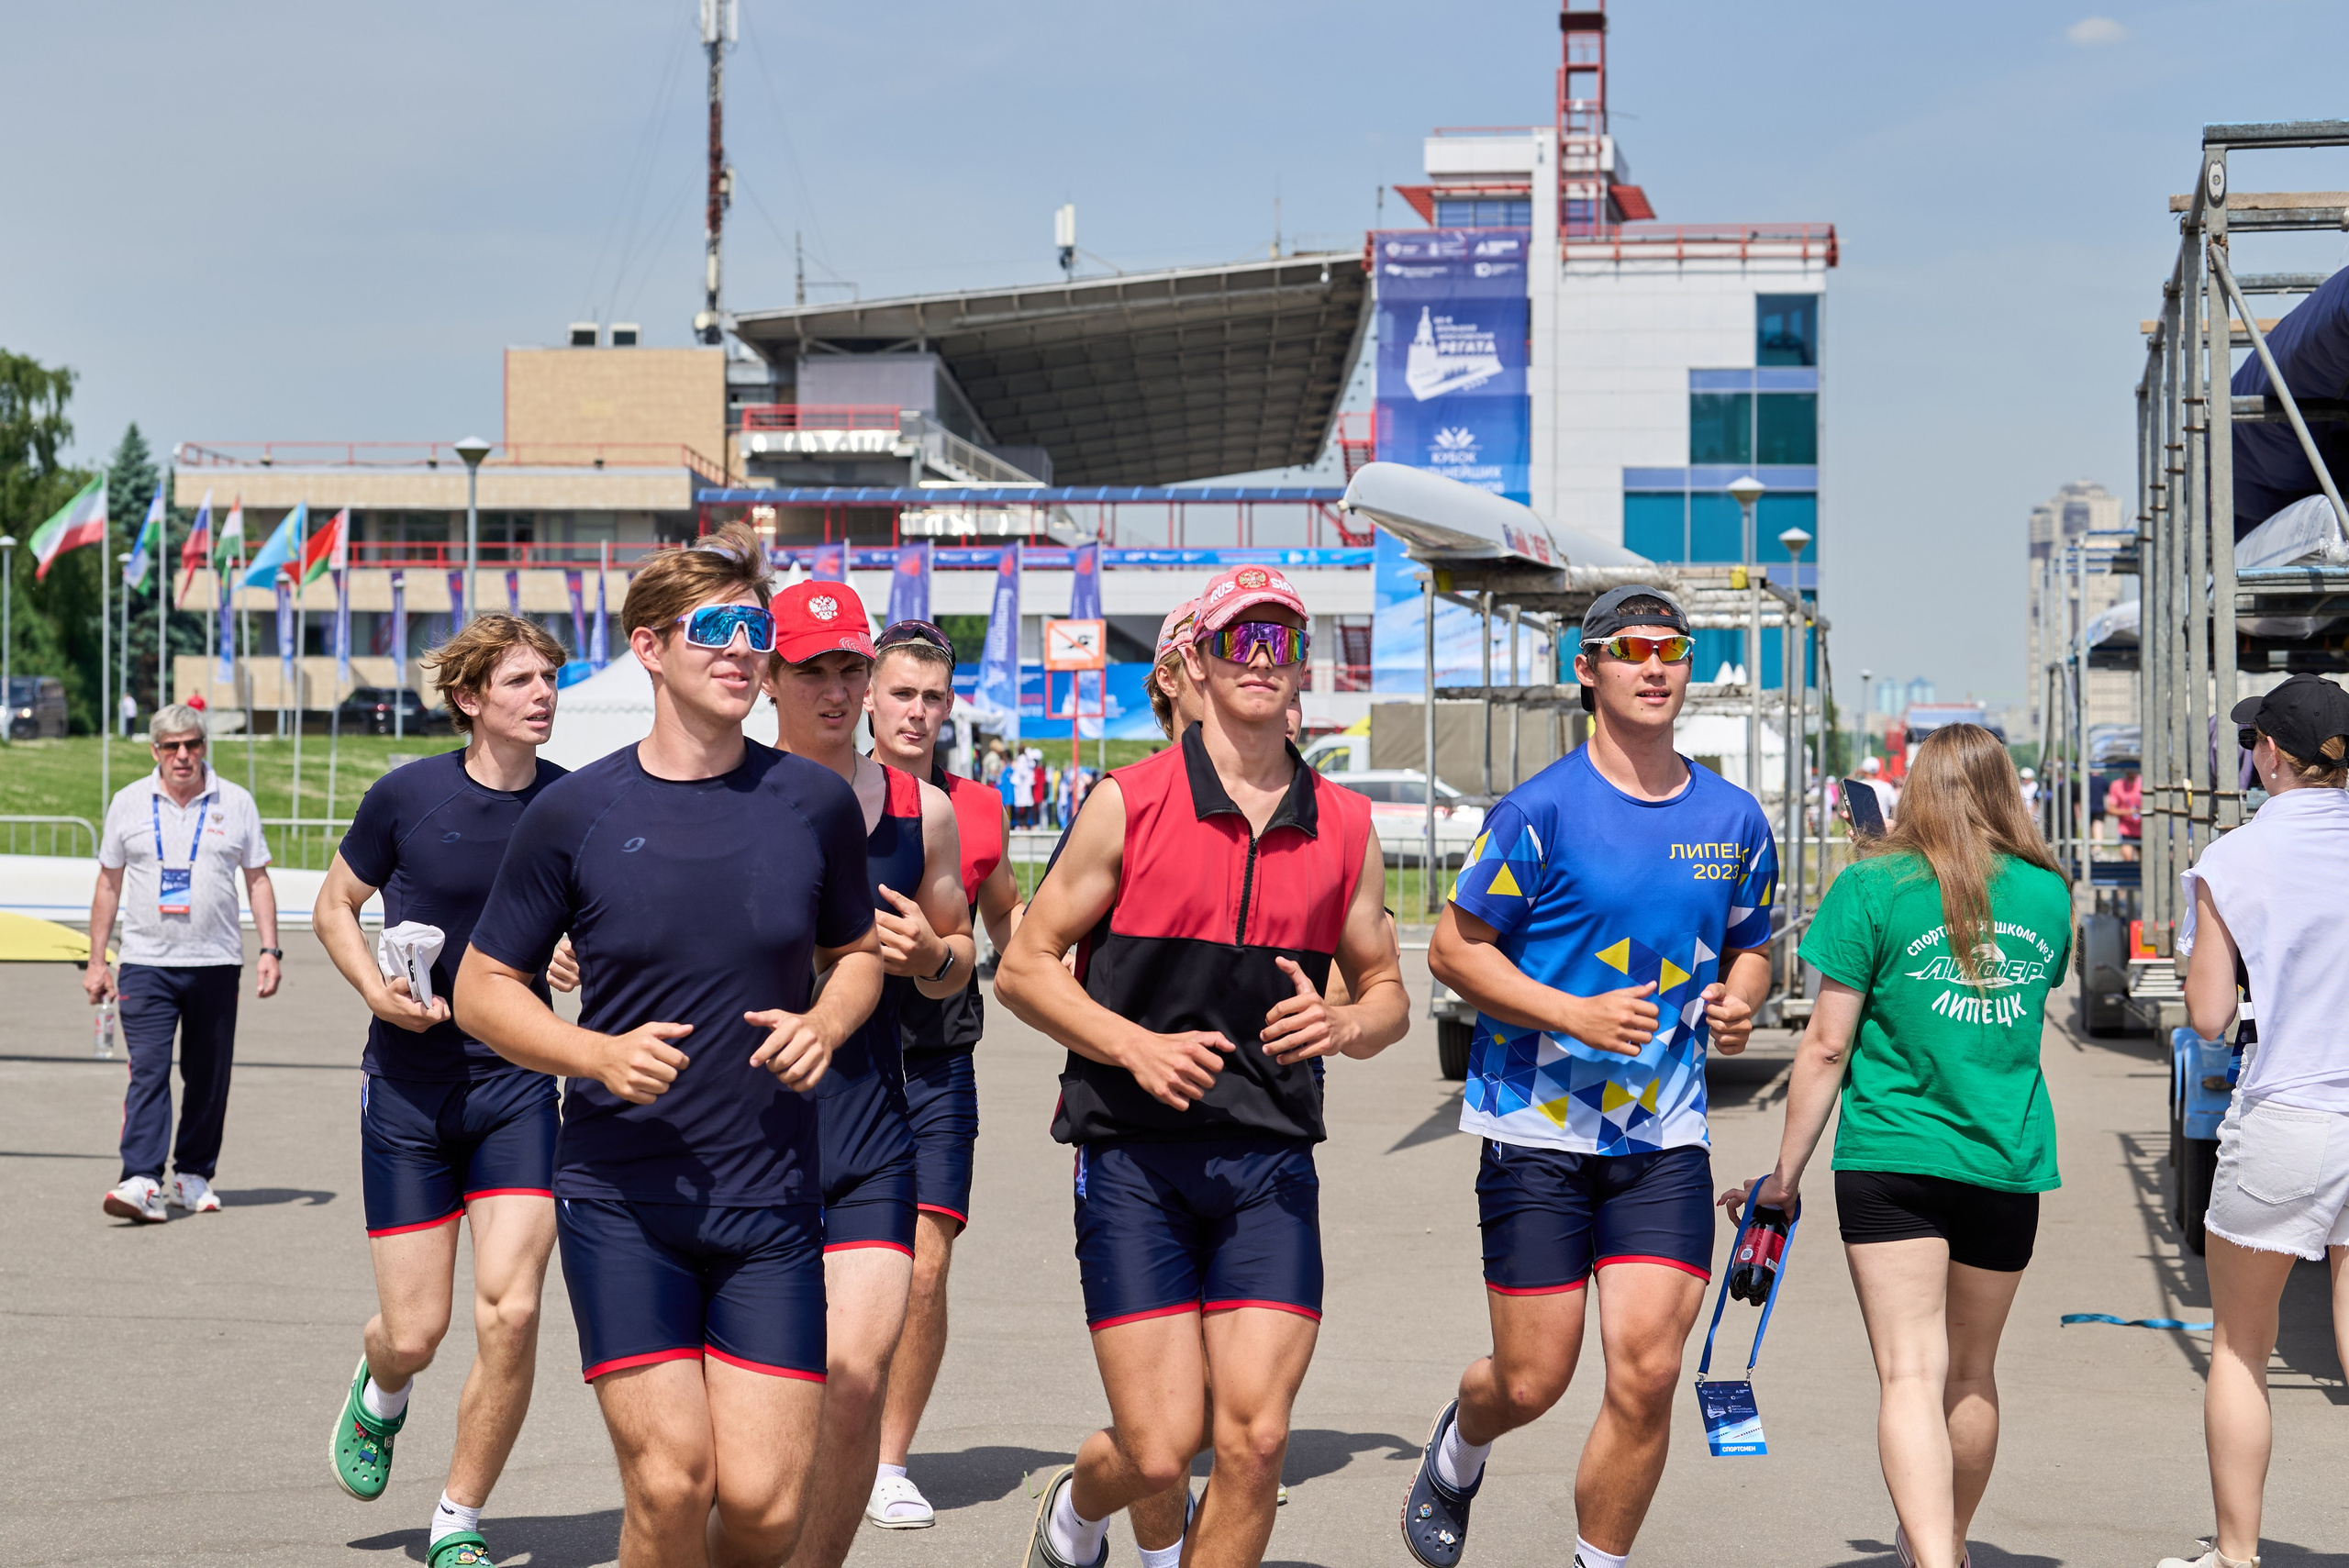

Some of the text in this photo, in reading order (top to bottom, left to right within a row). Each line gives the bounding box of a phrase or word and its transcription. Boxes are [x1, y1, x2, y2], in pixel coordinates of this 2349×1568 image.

[1438, 340, 1497, 353] РЕГАТА
[1431, 450, 1477, 463] КУБОК
[1209, 581, 1235, 604] RUS
[1692, 863, 1740, 880] 2023
[1932, 989, 2028, 1028] ЛИПЕЦК
